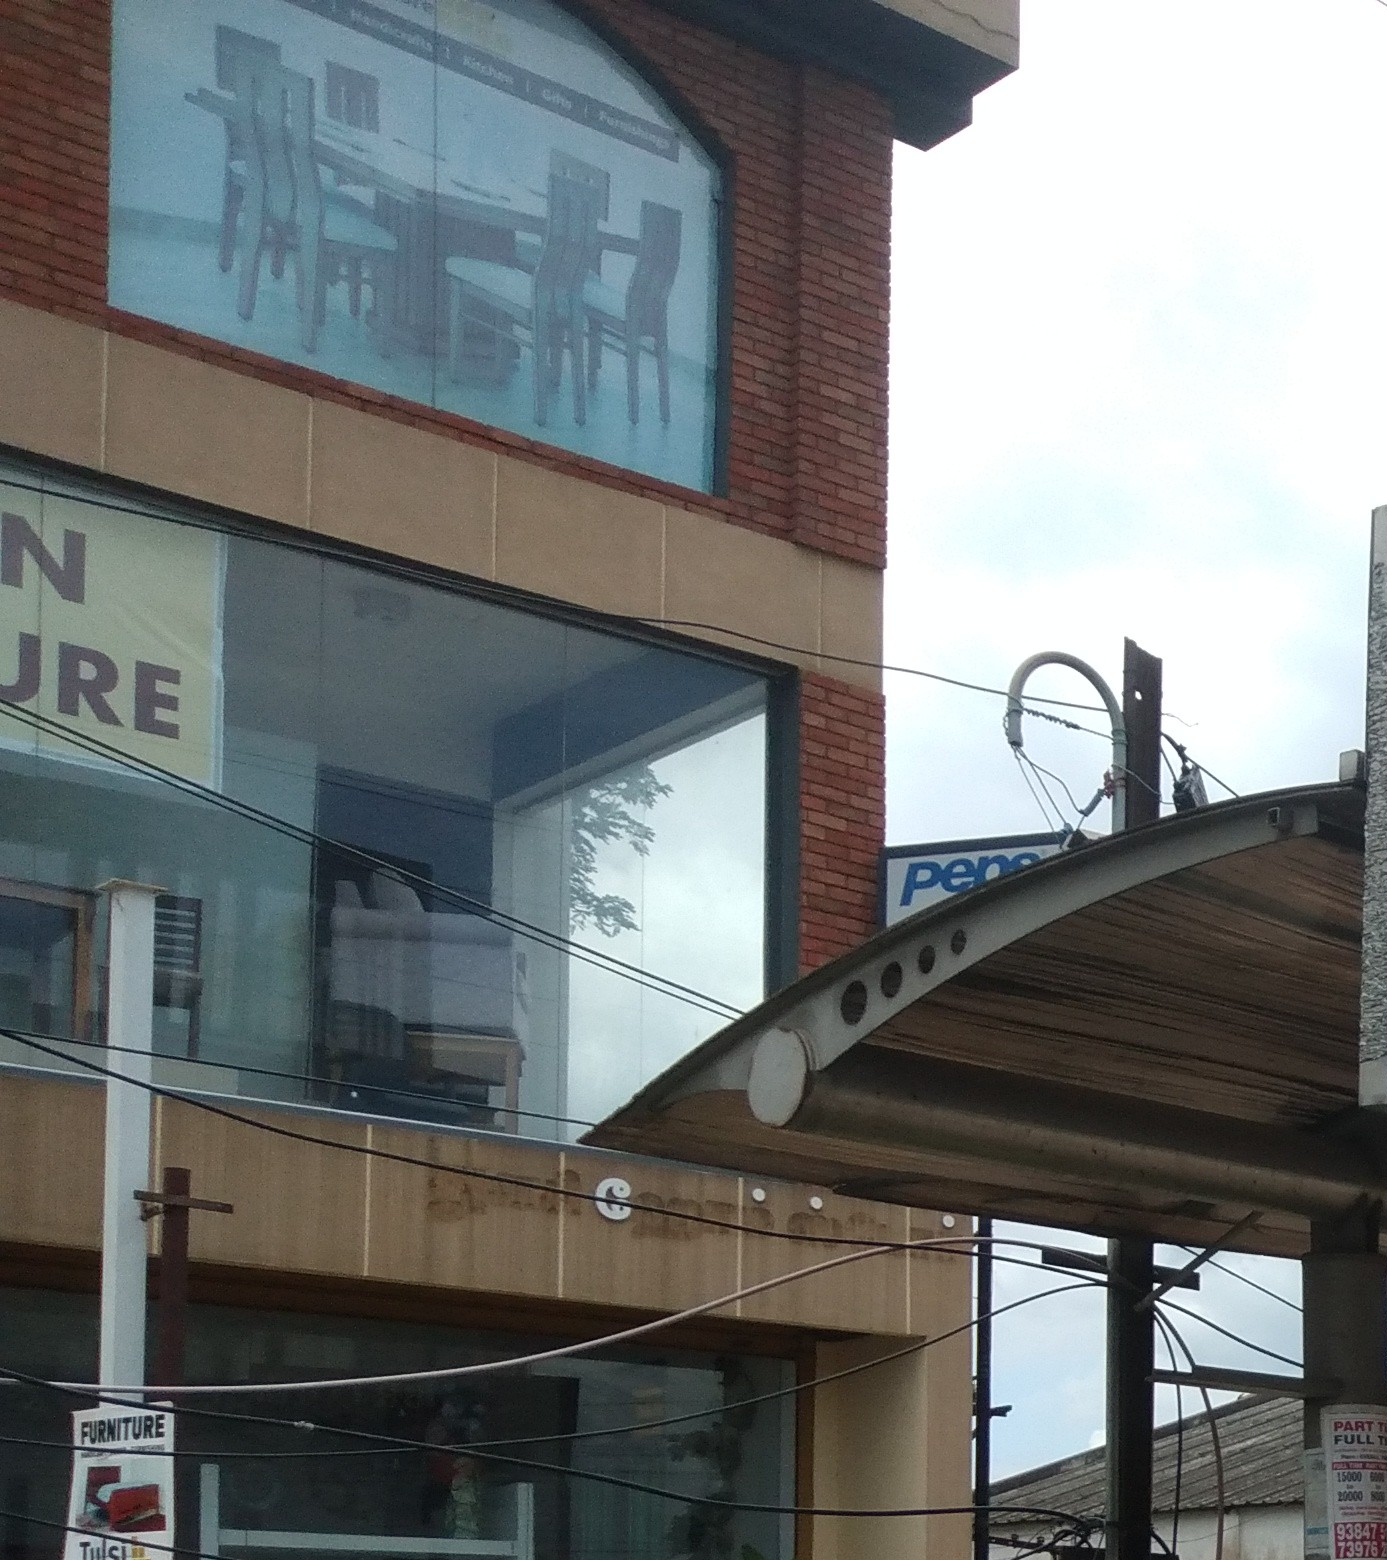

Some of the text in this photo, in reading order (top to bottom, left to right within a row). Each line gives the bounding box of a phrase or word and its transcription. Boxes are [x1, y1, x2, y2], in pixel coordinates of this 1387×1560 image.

[81, 1414, 165, 1445] FURNITURE
[1333, 1420, 1374, 1432] PART
[1333, 1434, 1375, 1445] FULL
[1336, 1471, 1363, 1483] 15000
[1337, 1490, 1364, 1502] 20000
[1336, 1523, 1378, 1541] 93847
[1337, 1540, 1378, 1558] 73976
